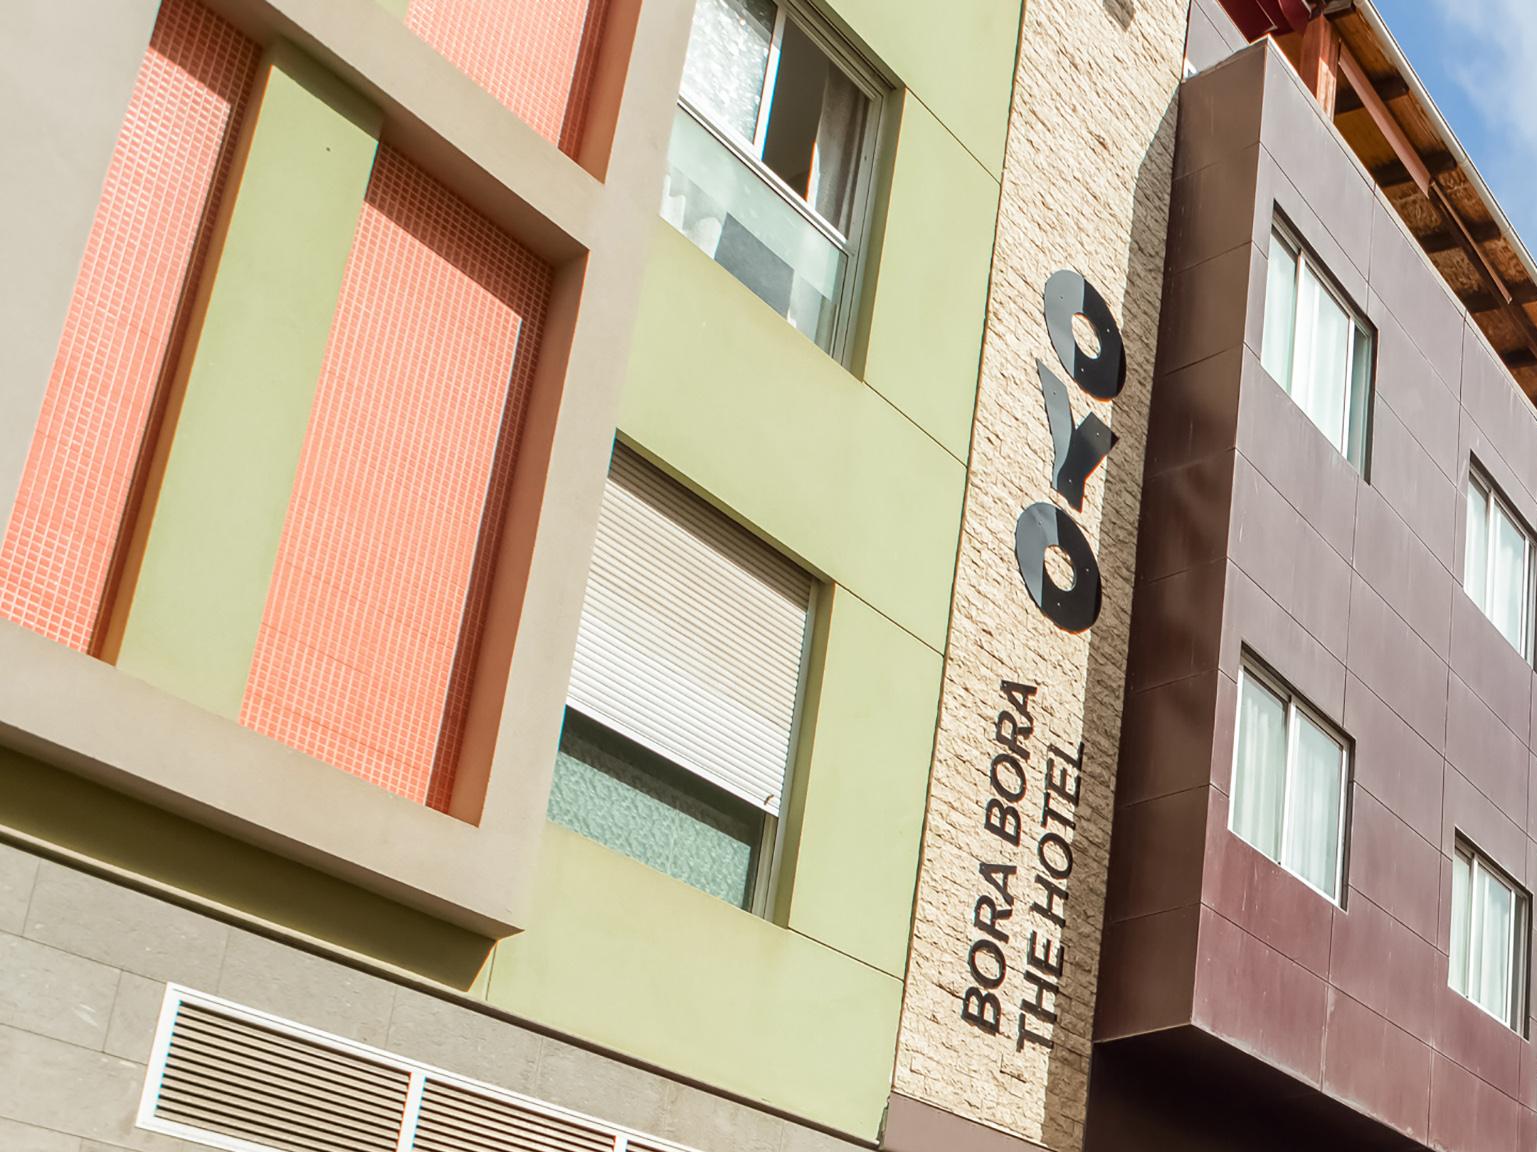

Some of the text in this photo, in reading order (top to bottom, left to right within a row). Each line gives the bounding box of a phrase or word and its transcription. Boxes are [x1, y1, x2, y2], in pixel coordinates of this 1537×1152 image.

[1014, 268, 1126, 633] OYO
[961, 680, 1038, 1037] BORA BORA
[1016, 741, 1085, 1053] THE HOTEL
